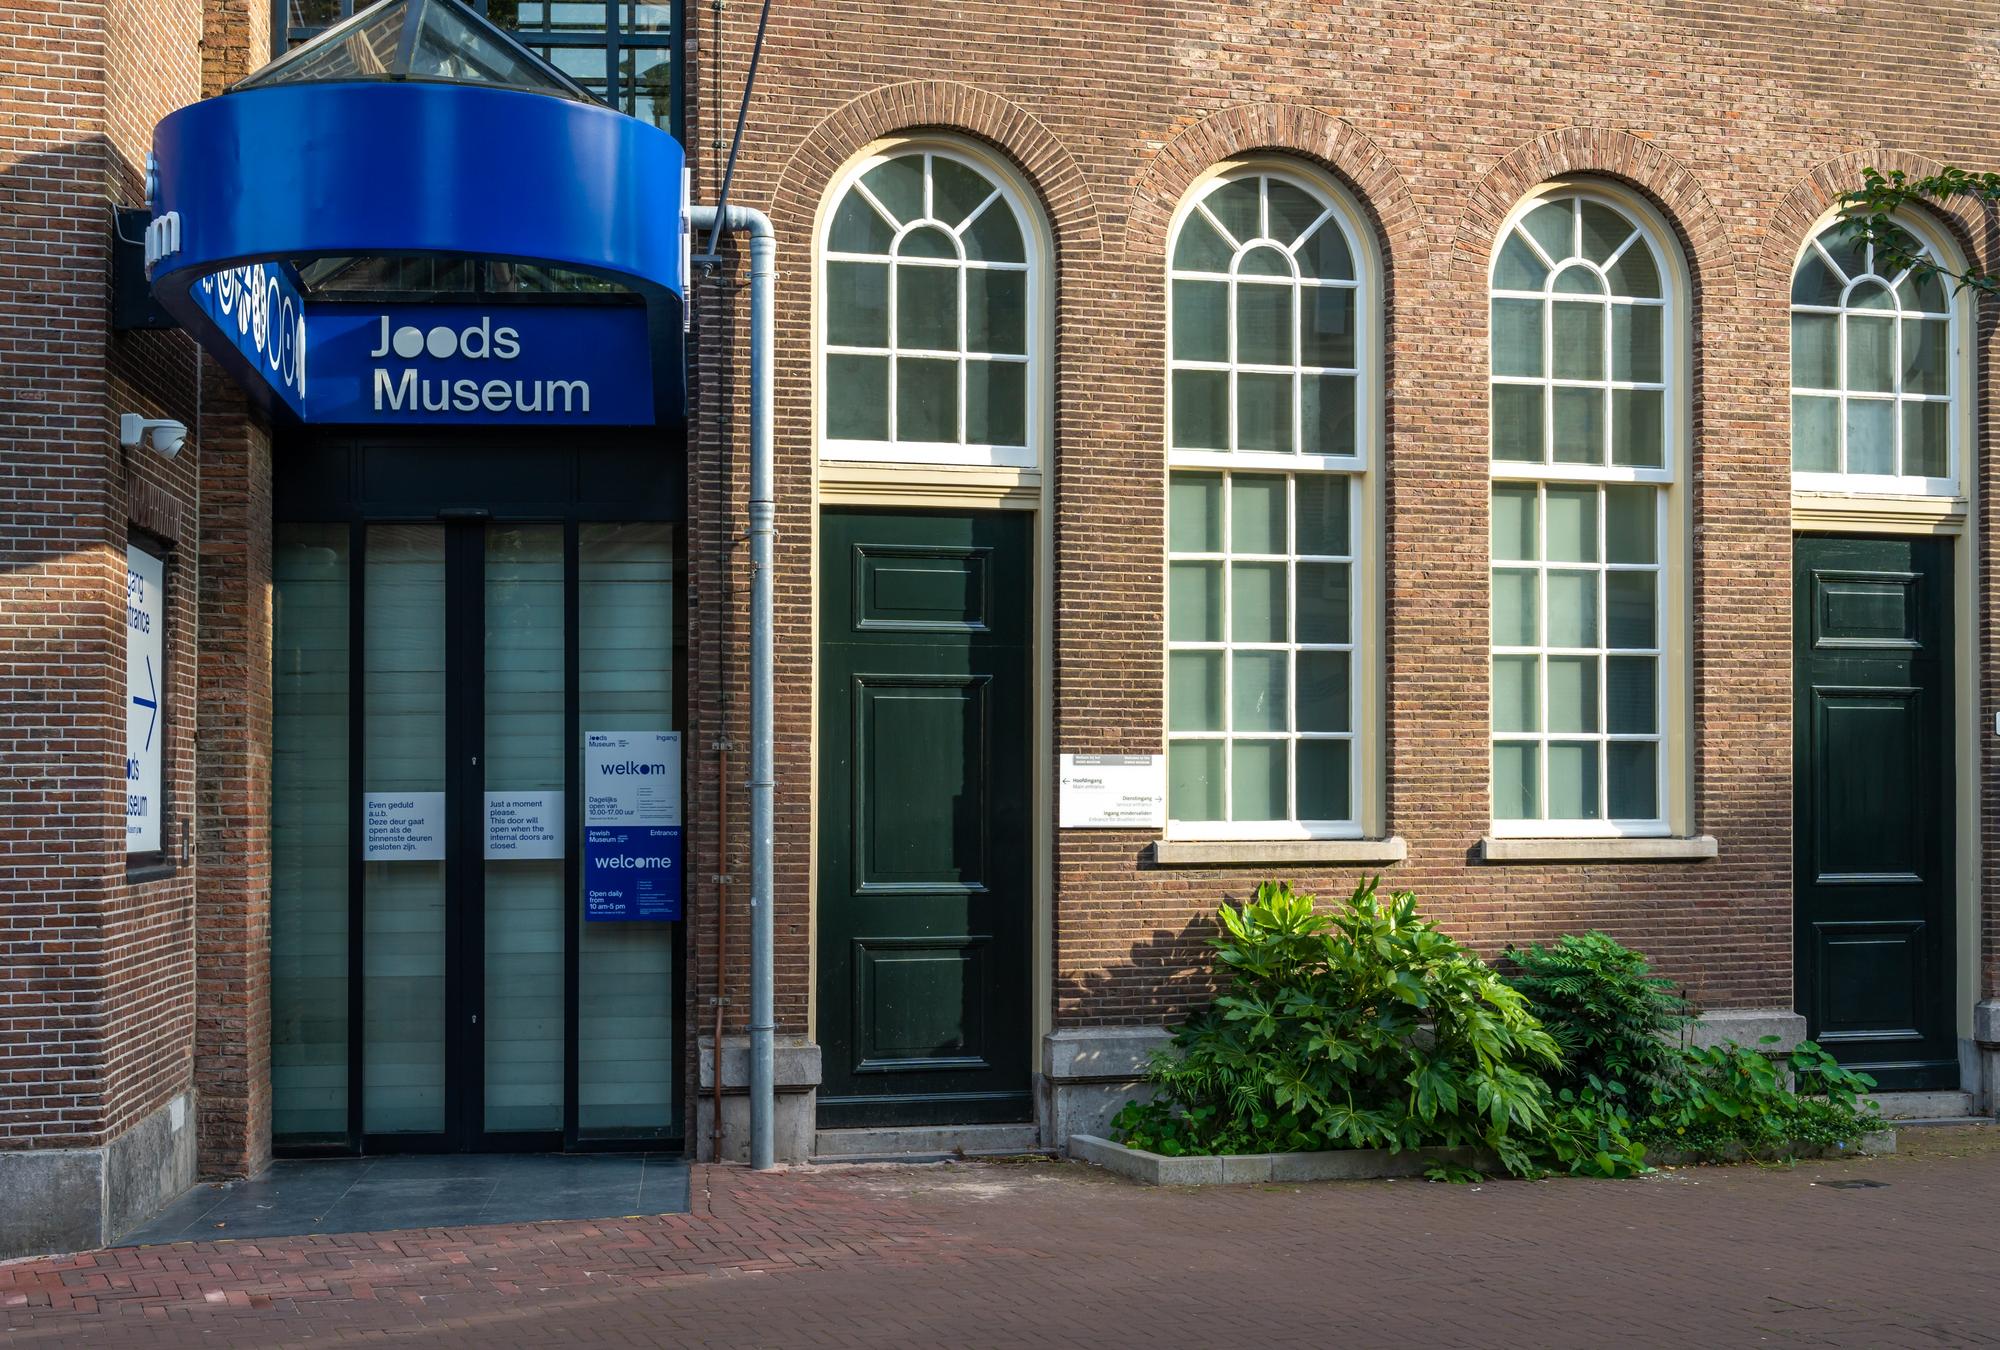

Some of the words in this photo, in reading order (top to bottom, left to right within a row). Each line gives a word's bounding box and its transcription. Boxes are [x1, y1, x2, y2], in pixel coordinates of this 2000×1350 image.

[371, 315, 521, 359] Joods
[374, 368, 590, 411] Museum
[601, 761, 666, 775] welkom
[388, 802, 414, 810] geduld
[408, 818, 424, 826] gaat
[368, 844, 402, 852] gesloten
[595, 854, 672, 869] welcome
